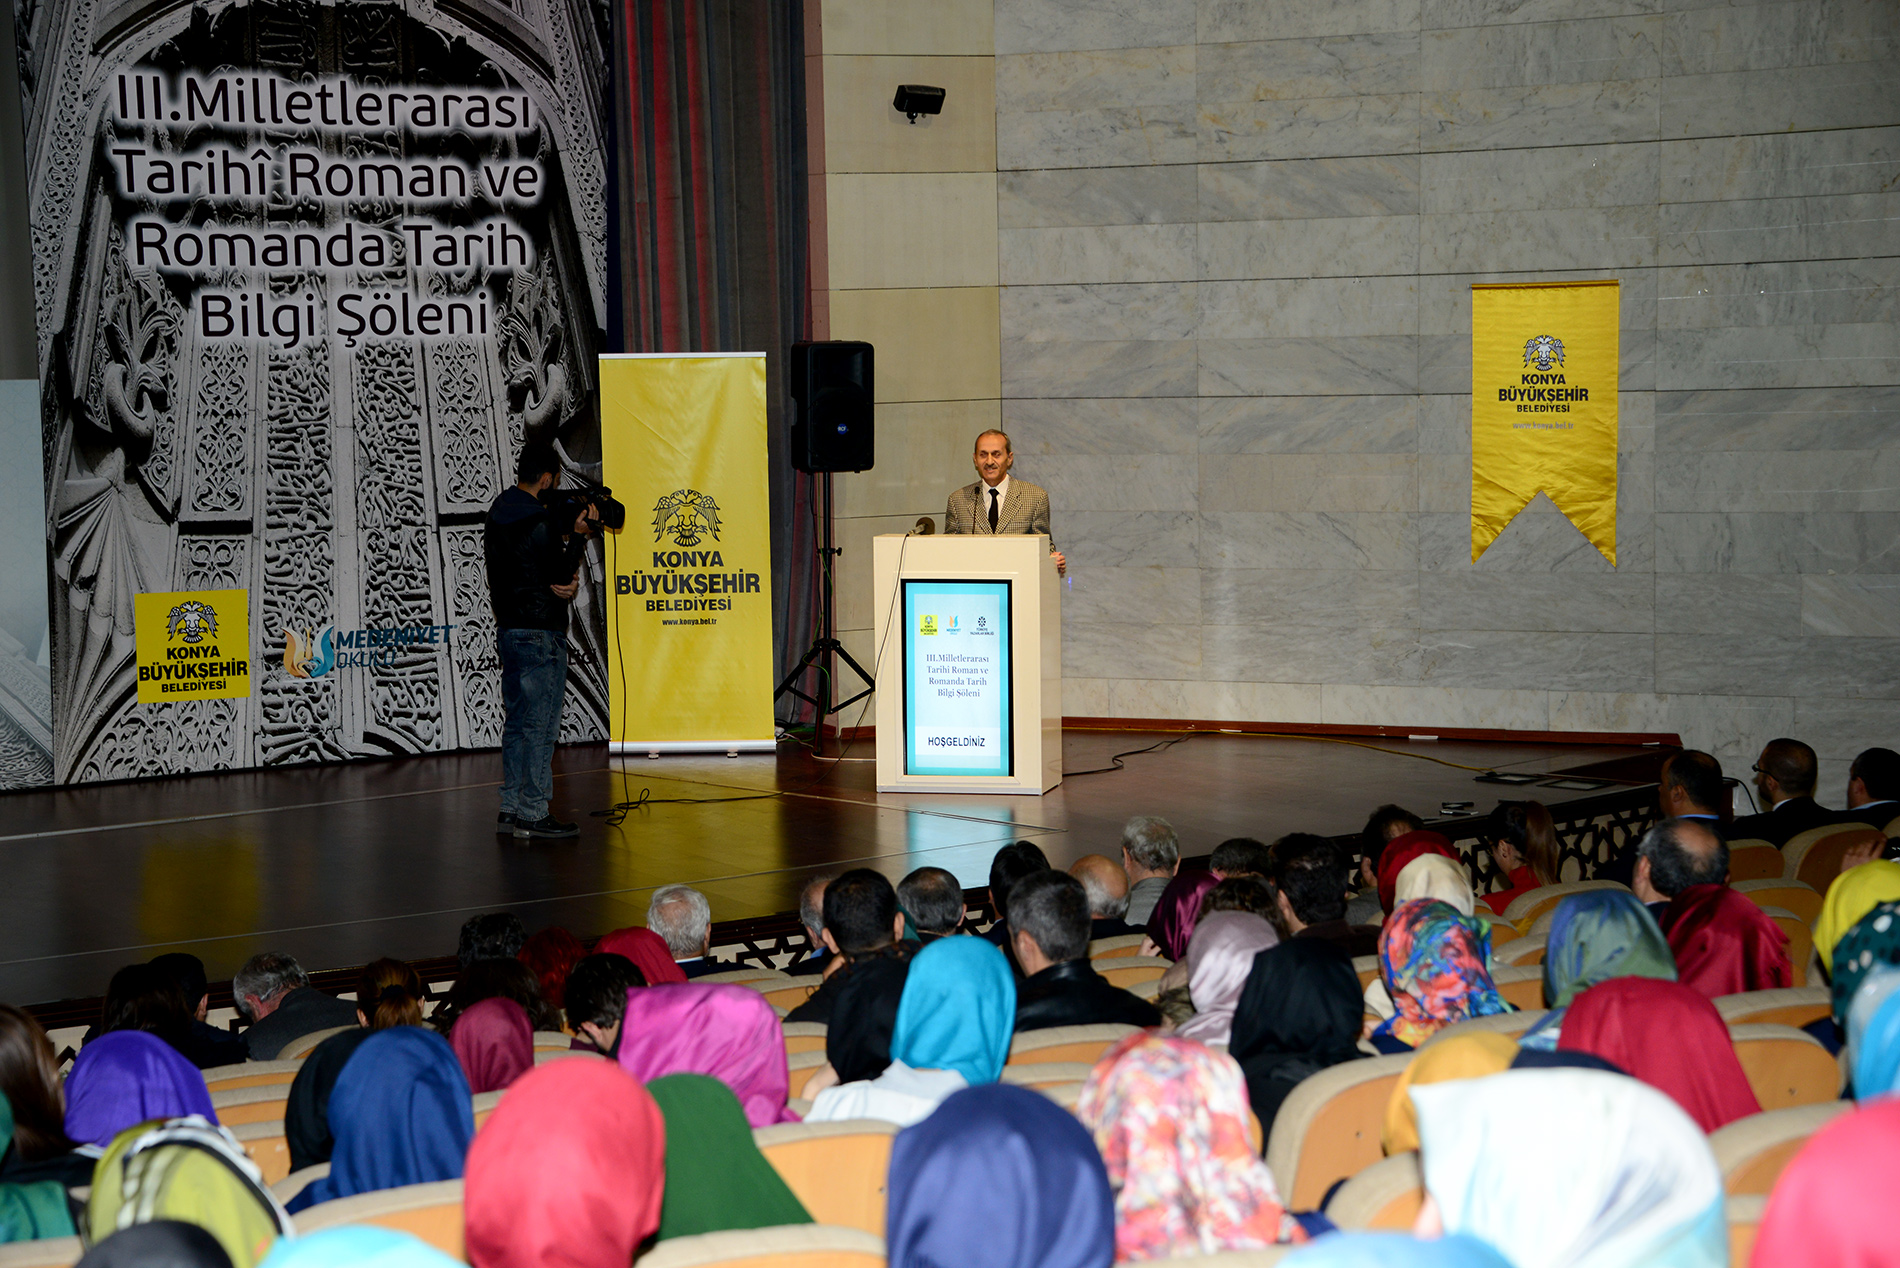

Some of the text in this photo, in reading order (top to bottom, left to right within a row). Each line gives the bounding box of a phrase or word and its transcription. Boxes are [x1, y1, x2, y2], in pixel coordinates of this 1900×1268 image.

[118, 75, 529, 128] III.Milletlerarası
[112, 148, 538, 197] Tarihî Roman ve
[135, 222, 526, 267] Romanda Tarih
[201, 292, 487, 349] Bilgi Şöleni
[1521, 374, 1566, 385] KONYA
[1498, 386, 1589, 403] BÜYÜKŞEHİR
[1516, 403, 1570, 413] BELEDİYESİ
[1512, 421, 1574, 431] www.konya.bel.tr
[652, 551, 724, 568] KONYA
[616, 569, 760, 597] BÜYÜKŞEHİR
[646, 596, 732, 612] BELEDİYESİ
[662, 618, 717, 626] www.konya.bel.tr
[166, 645, 221, 660] KONYA
[926, 654, 989, 663] III.Milletlerarası
[139, 658, 248, 682] BÜYÜKŞEHİR
[951, 665, 979, 674] Roman
[161, 678, 227, 693] BELEDİYESİ
[928, 676, 988, 686] Romanda Tarih
[937, 688, 981, 698] Bilgi Şöleni
[928, 735, 985, 748] HOŞGELDİNİZ
